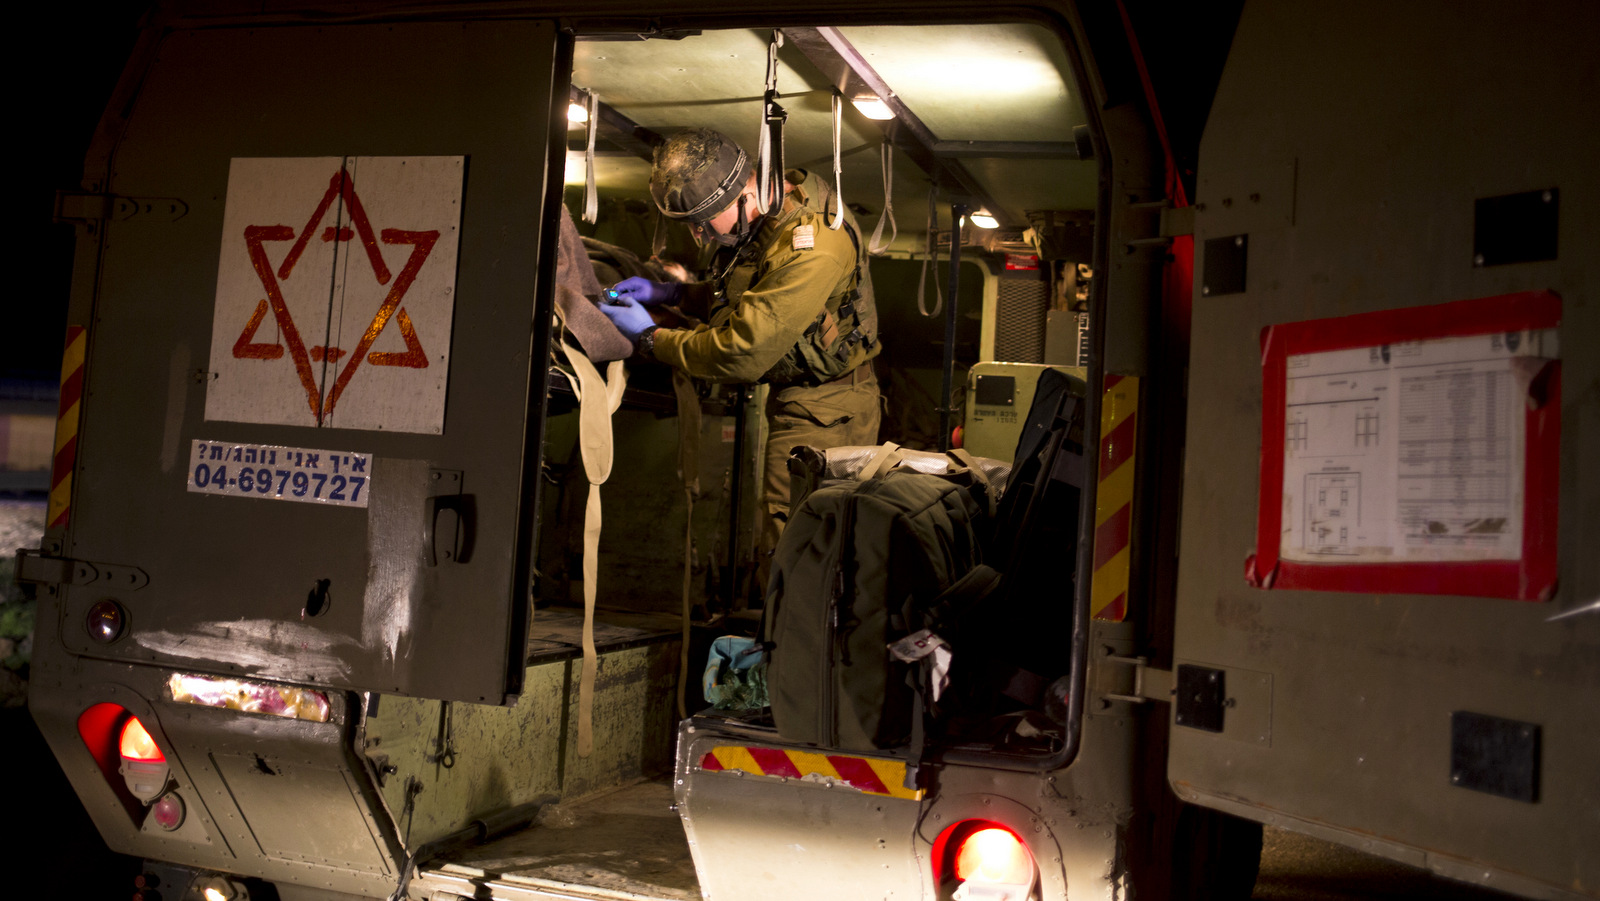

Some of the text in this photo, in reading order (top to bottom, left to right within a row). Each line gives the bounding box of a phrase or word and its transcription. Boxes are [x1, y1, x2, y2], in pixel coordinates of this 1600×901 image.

[198, 443, 366, 473] איך אני נוהג/ת?
[194, 463, 366, 502] 04-6979727
